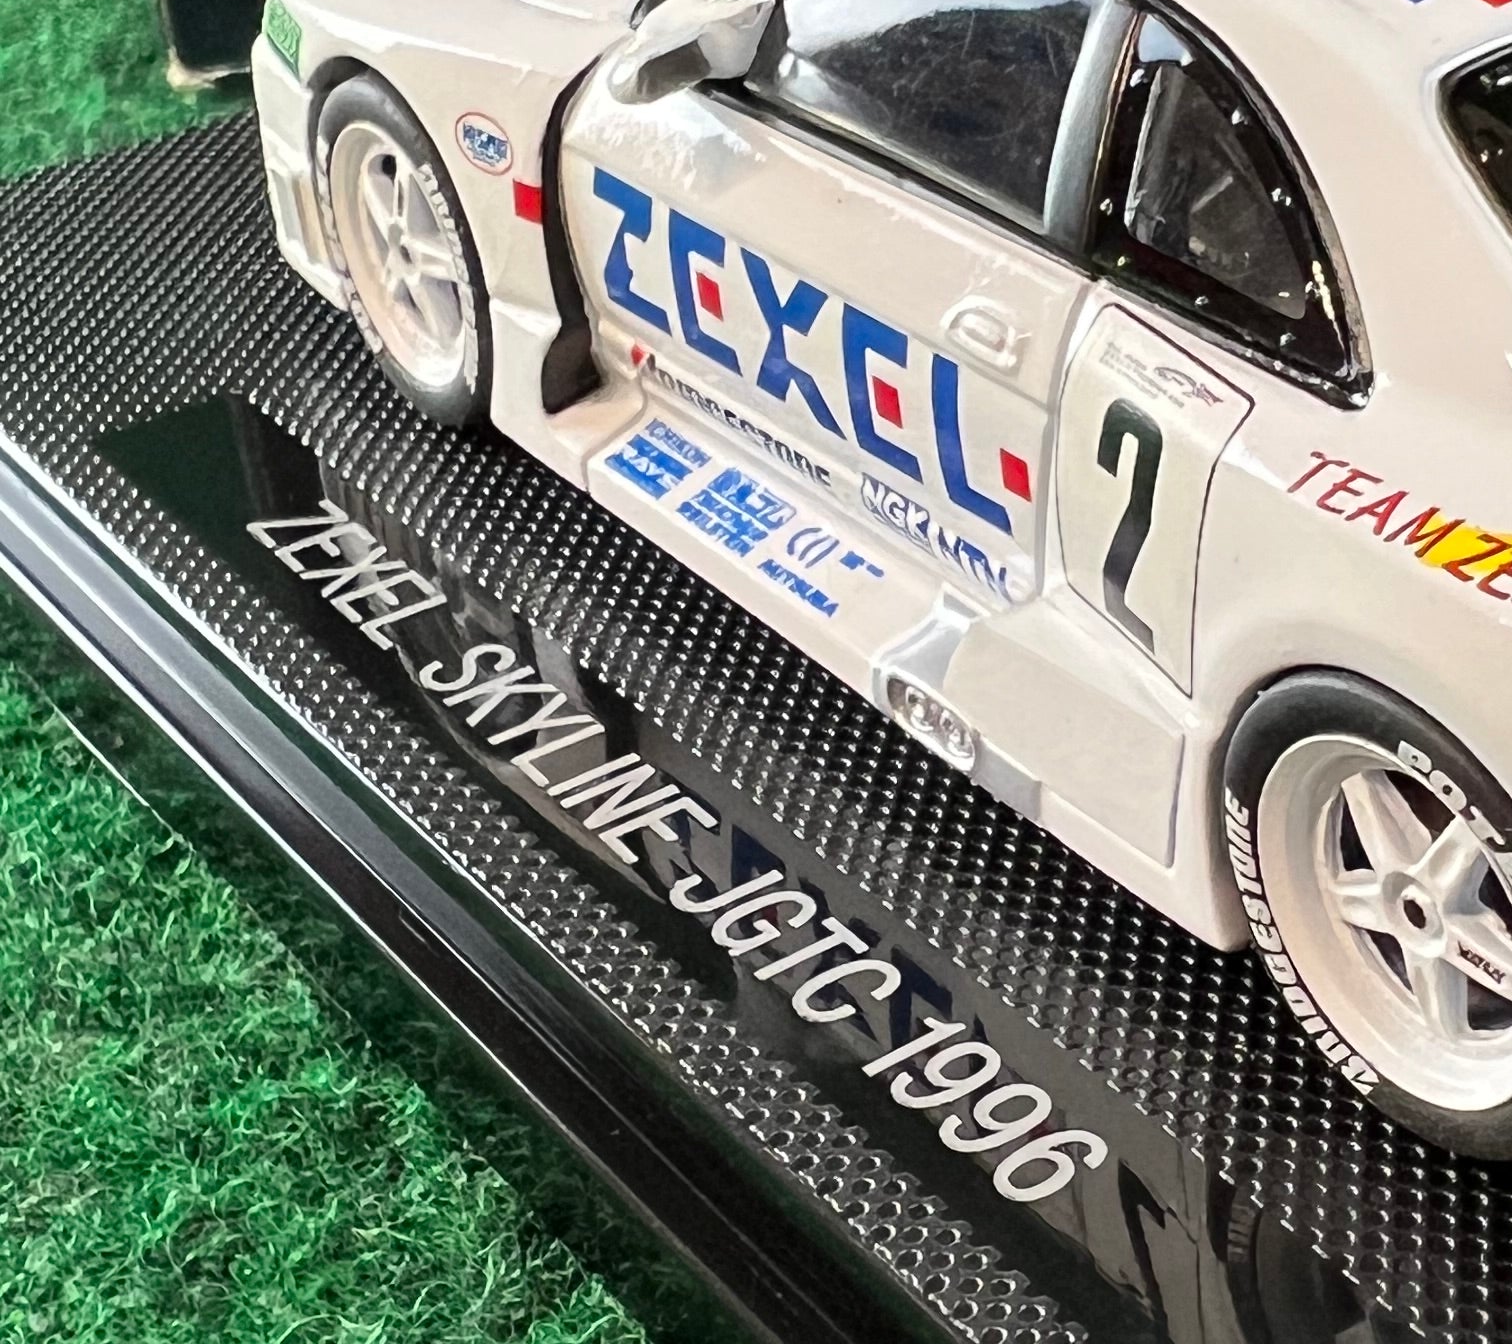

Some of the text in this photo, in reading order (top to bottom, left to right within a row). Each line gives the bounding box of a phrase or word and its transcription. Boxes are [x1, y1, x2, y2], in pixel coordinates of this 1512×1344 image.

[593, 166, 1013, 536] ZEXEL
[862, 475, 932, 550] NGK
[1096, 397, 1163, 656] 2
[1287, 452, 1464, 558] TEAM
[247, 499, 1110, 1203] ZEXEL SKYLINE JGTC 1996
[1224, 786, 1381, 1096] BRIDGESTONE
